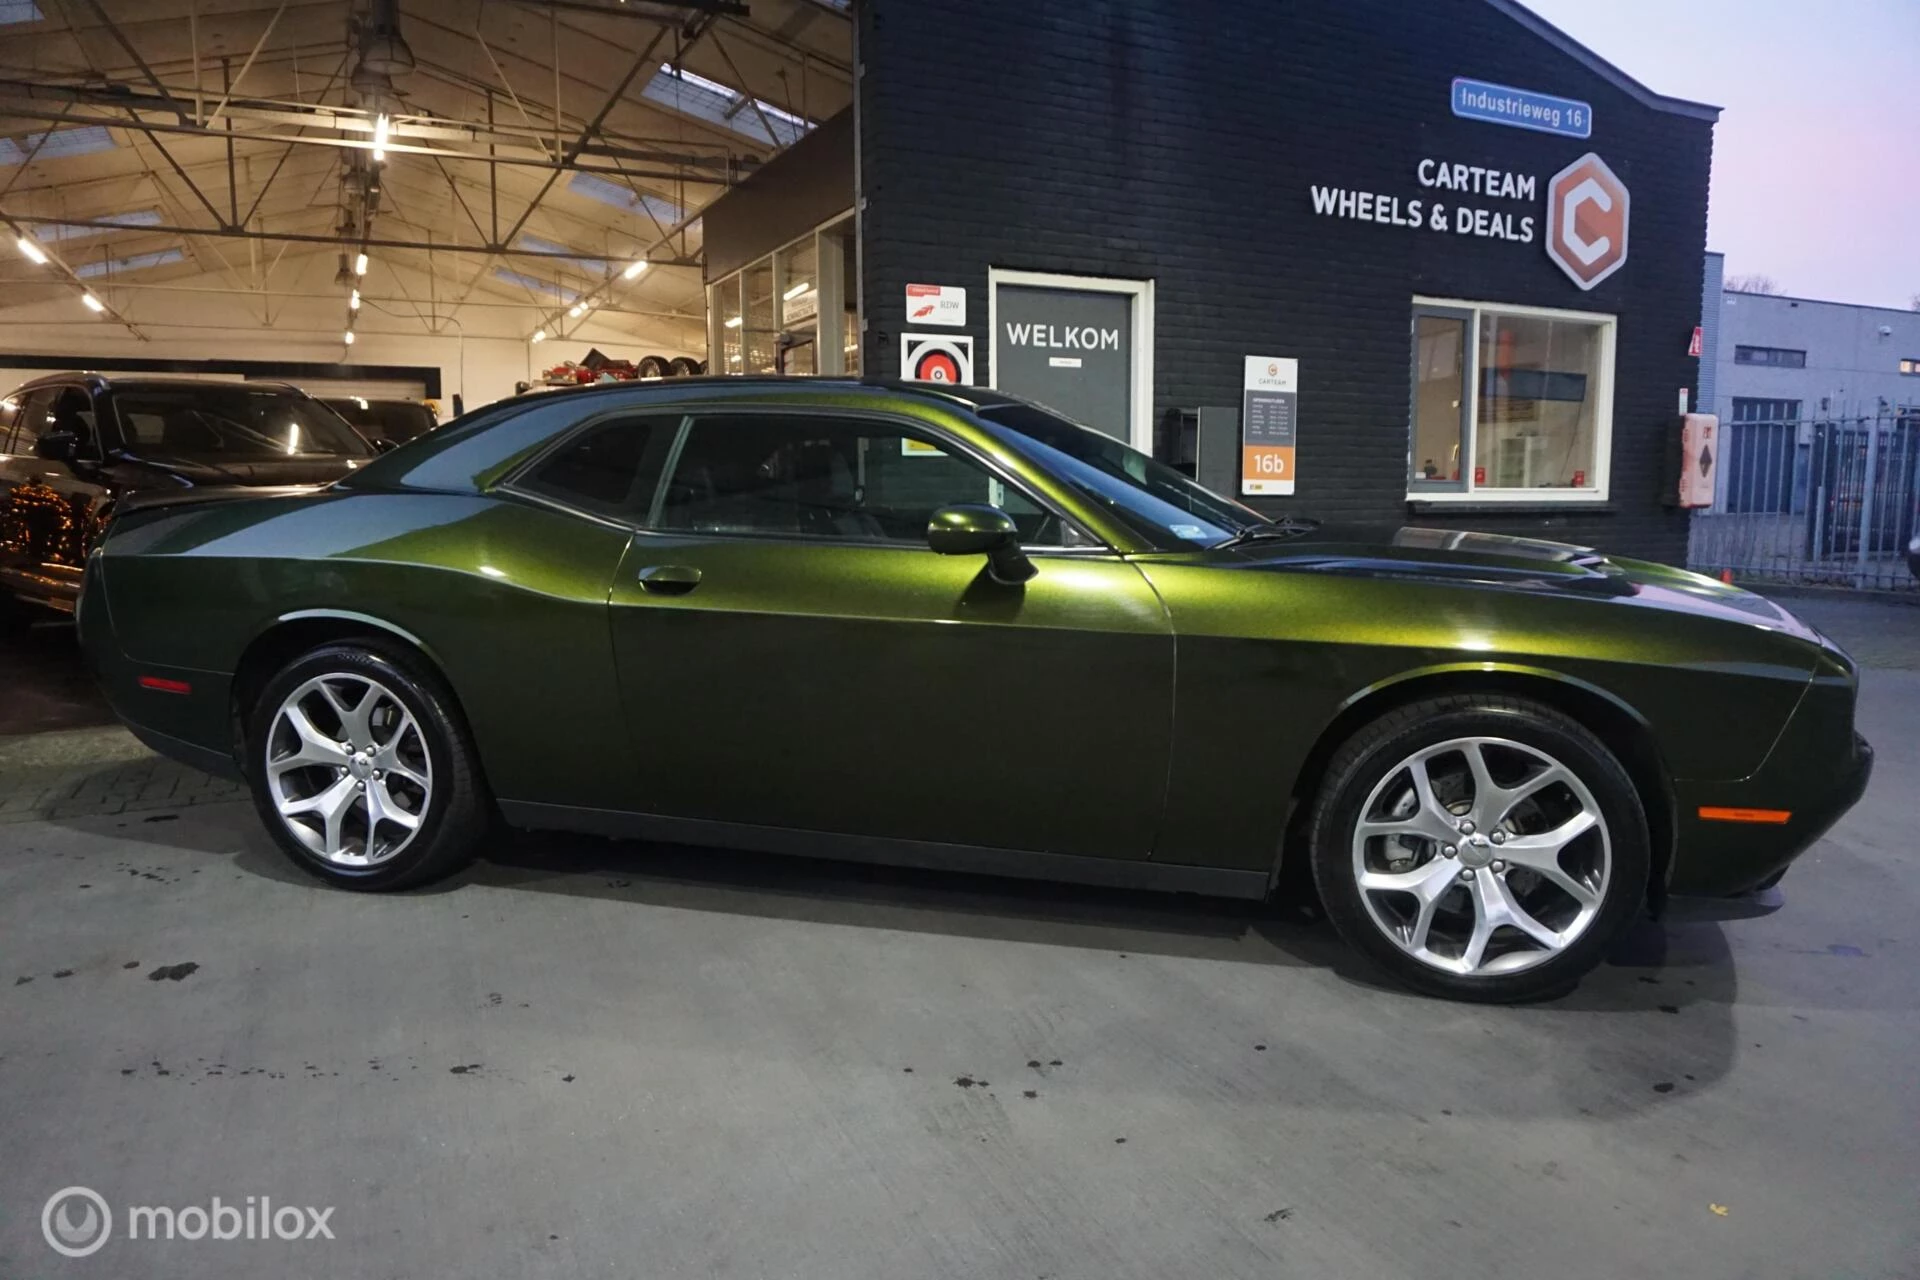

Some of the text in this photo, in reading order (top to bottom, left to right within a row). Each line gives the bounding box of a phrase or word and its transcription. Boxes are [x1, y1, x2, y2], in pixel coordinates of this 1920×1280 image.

[1461, 87, 1583, 127] Industrieweg 16
[1418, 158, 1536, 201] CARTEAM
[1311, 185, 1535, 244] WHEELS & DEALS
[940, 300, 960, 309] RDW
[1006, 322, 1119, 351] WELKOM
[1254, 453, 1284, 474] 16b
